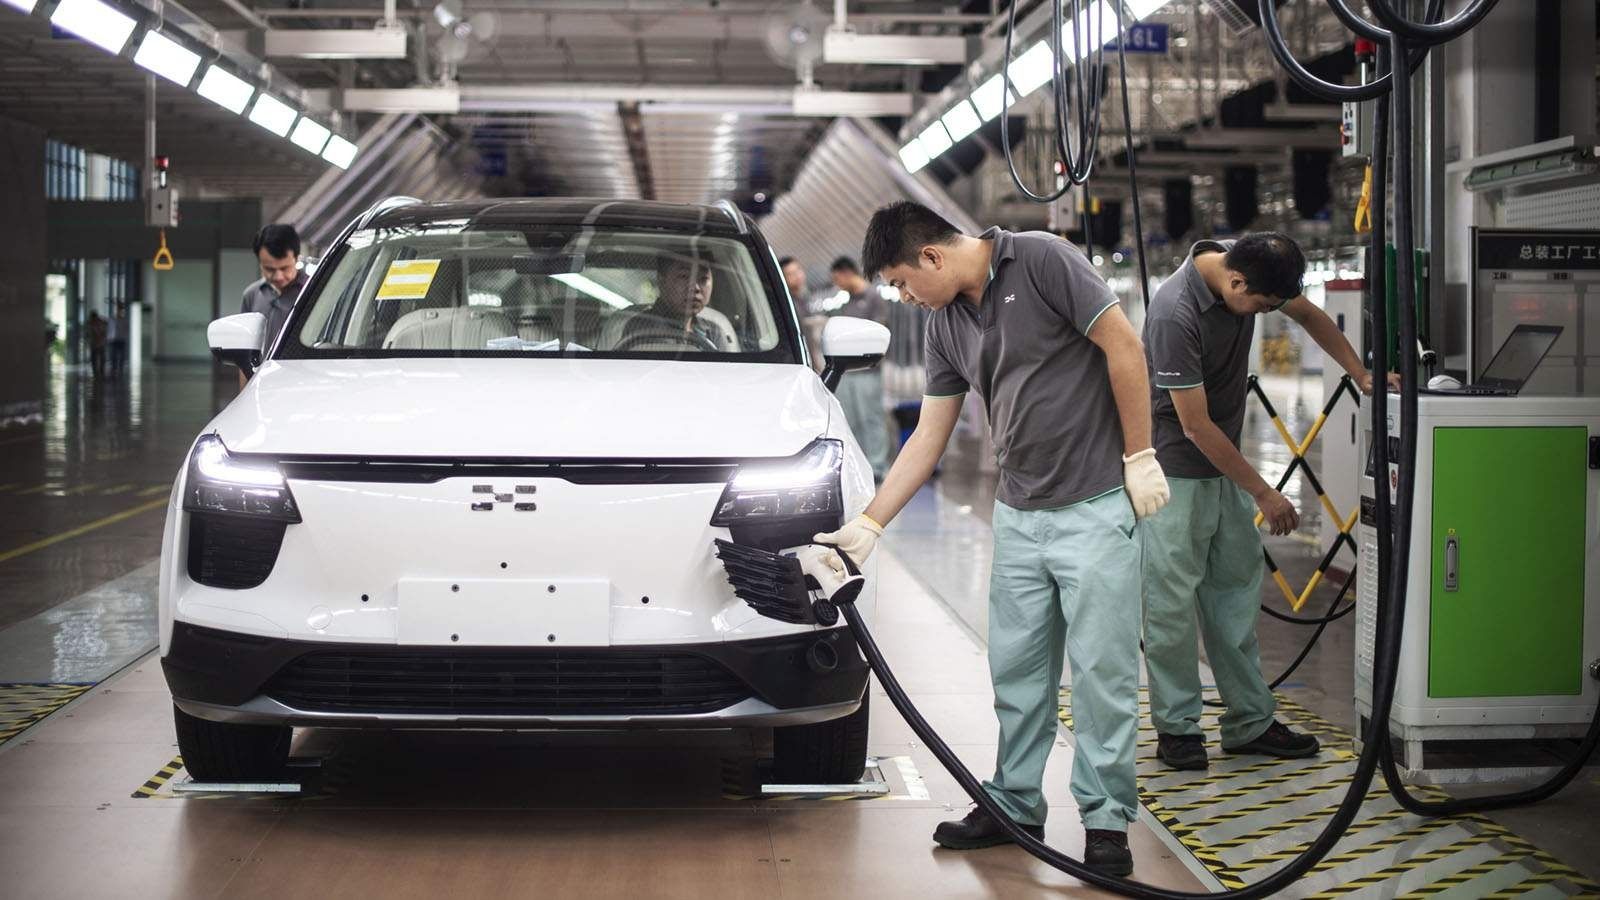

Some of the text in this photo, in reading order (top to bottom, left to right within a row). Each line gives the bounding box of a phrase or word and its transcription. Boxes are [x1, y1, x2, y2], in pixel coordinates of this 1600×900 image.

[1519, 244, 1600, 259] 总装工厂工
